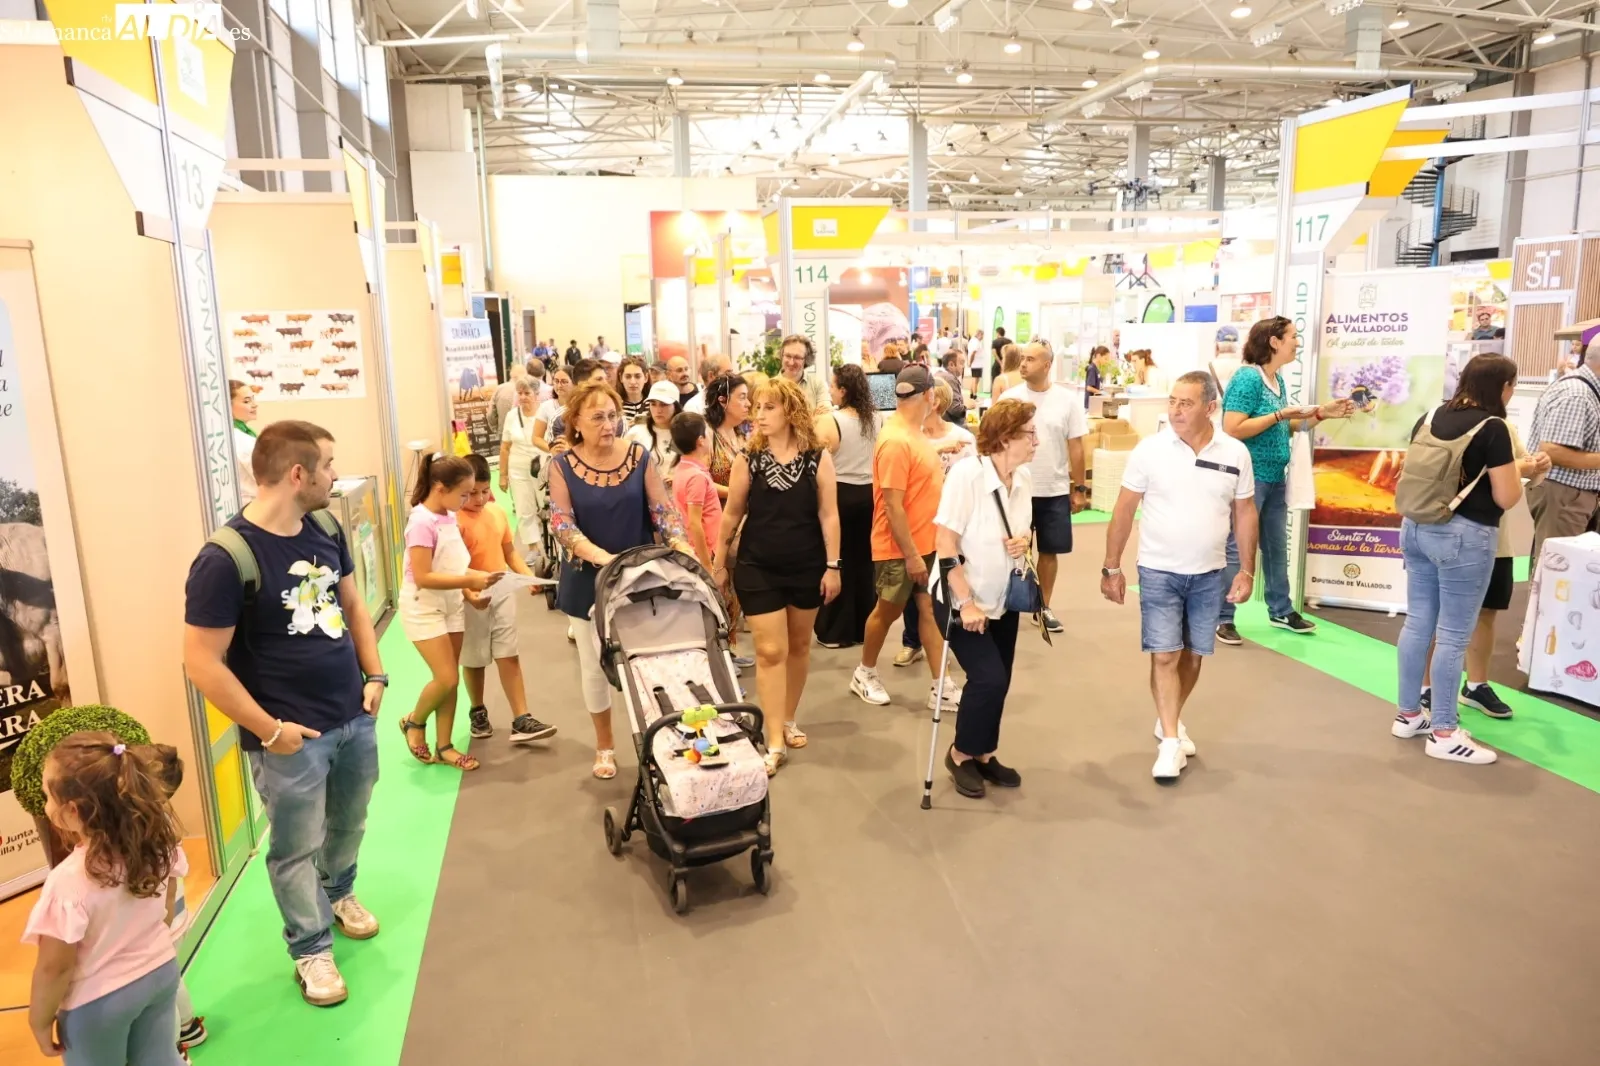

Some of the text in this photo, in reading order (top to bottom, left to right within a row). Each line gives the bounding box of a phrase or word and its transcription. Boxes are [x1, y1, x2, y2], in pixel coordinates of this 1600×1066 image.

[1296, 214, 1329, 243] 117
[794, 265, 829, 284] 114
[1326, 312, 1409, 324] ALIMENTOS
[1326, 324, 1408, 334] DE VALLADOLID
[1341, 337, 1365, 349] gusto
[195, 252, 231, 487] SALAMANCA
[1327, 529, 1382, 543] Siente los
[1343, 542, 1358, 552] de
[1360, 544, 1372, 553] la
[1356, 580, 1393, 590] VALLADOLID
[6, 829, 34, 845] Junta
[17, 842, 23, 852] y
